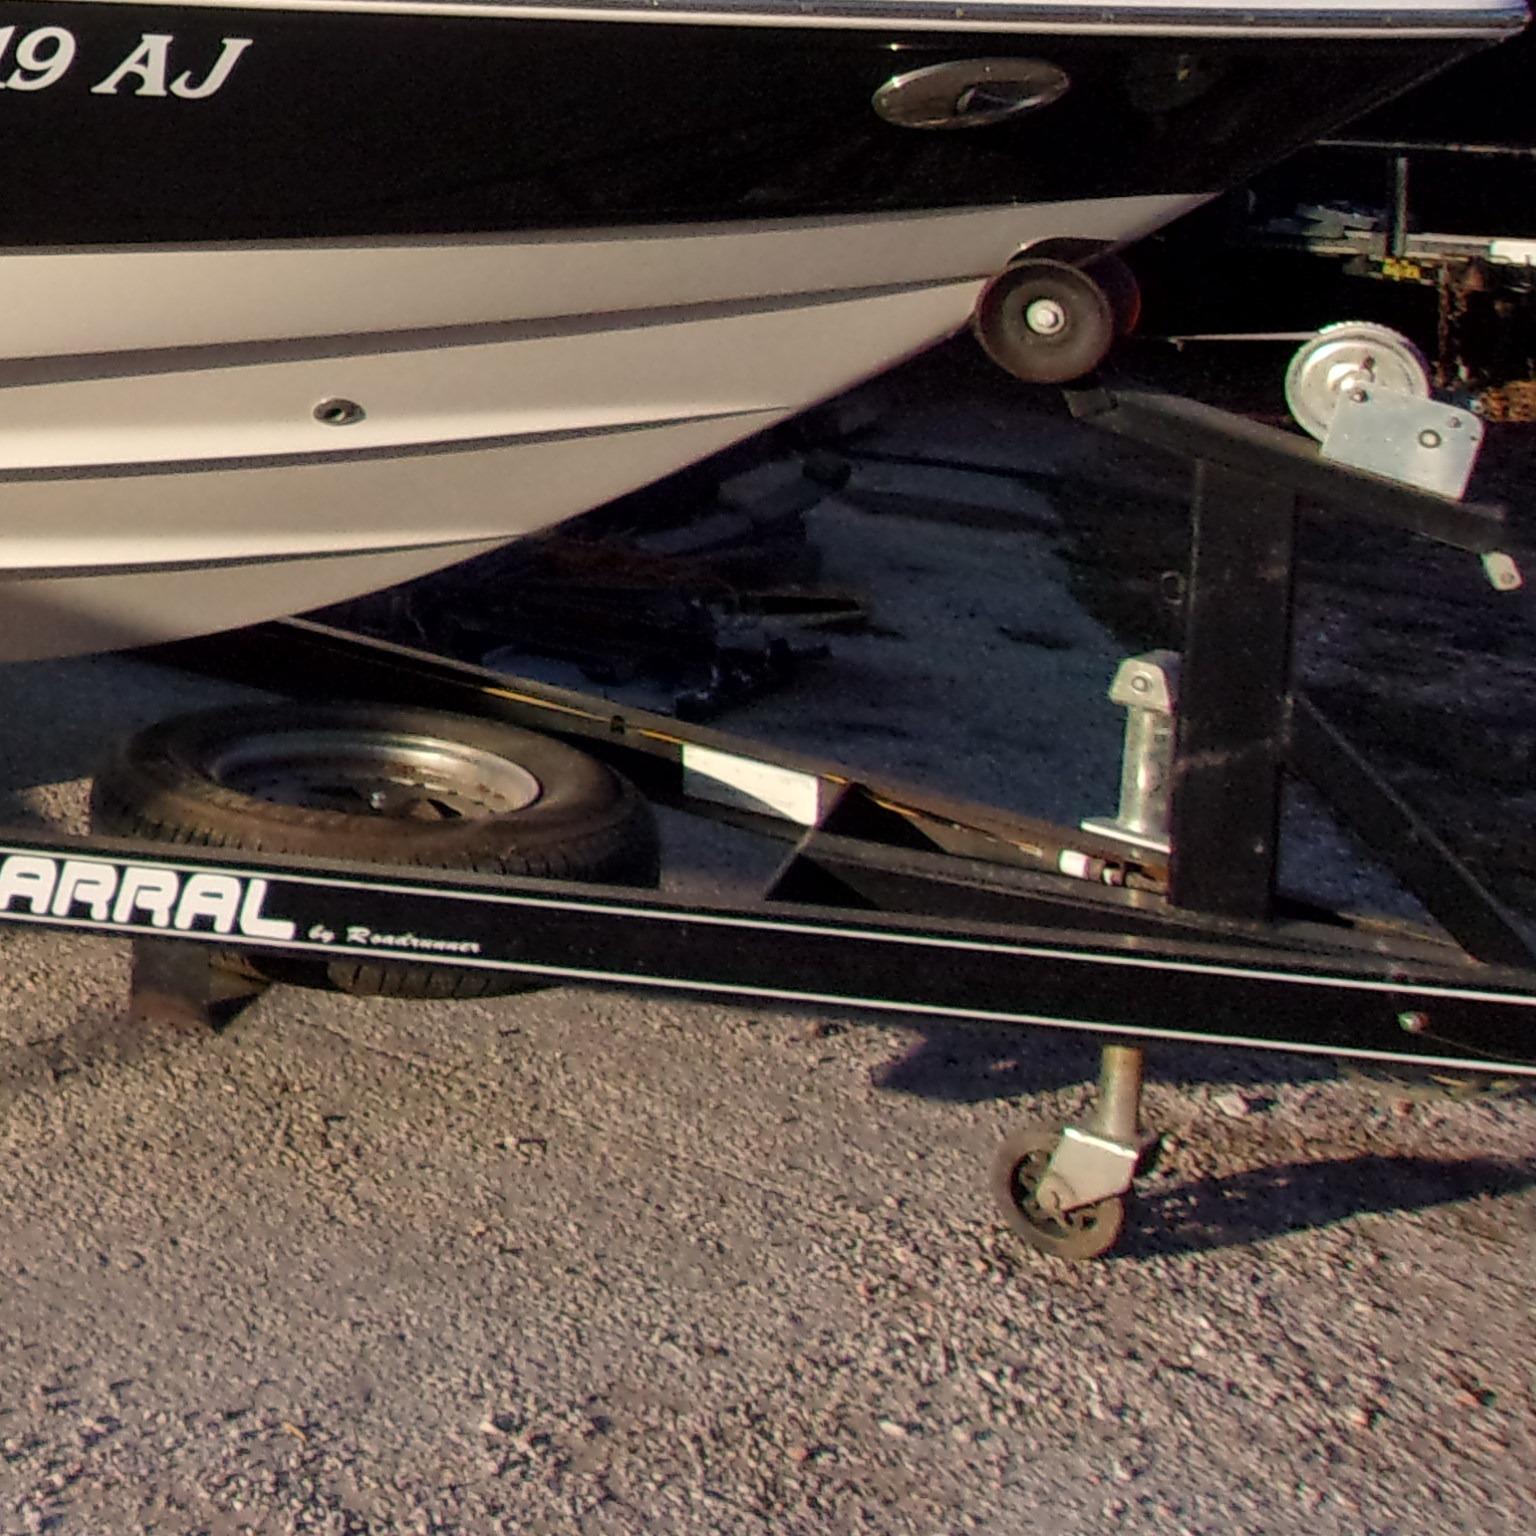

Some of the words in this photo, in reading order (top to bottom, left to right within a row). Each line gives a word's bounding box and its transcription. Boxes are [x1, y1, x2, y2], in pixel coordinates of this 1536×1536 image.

[90, 33, 254, 100] AJ
[308, 924, 336, 944] by
[346, 926, 482, 954] Roadrunner
